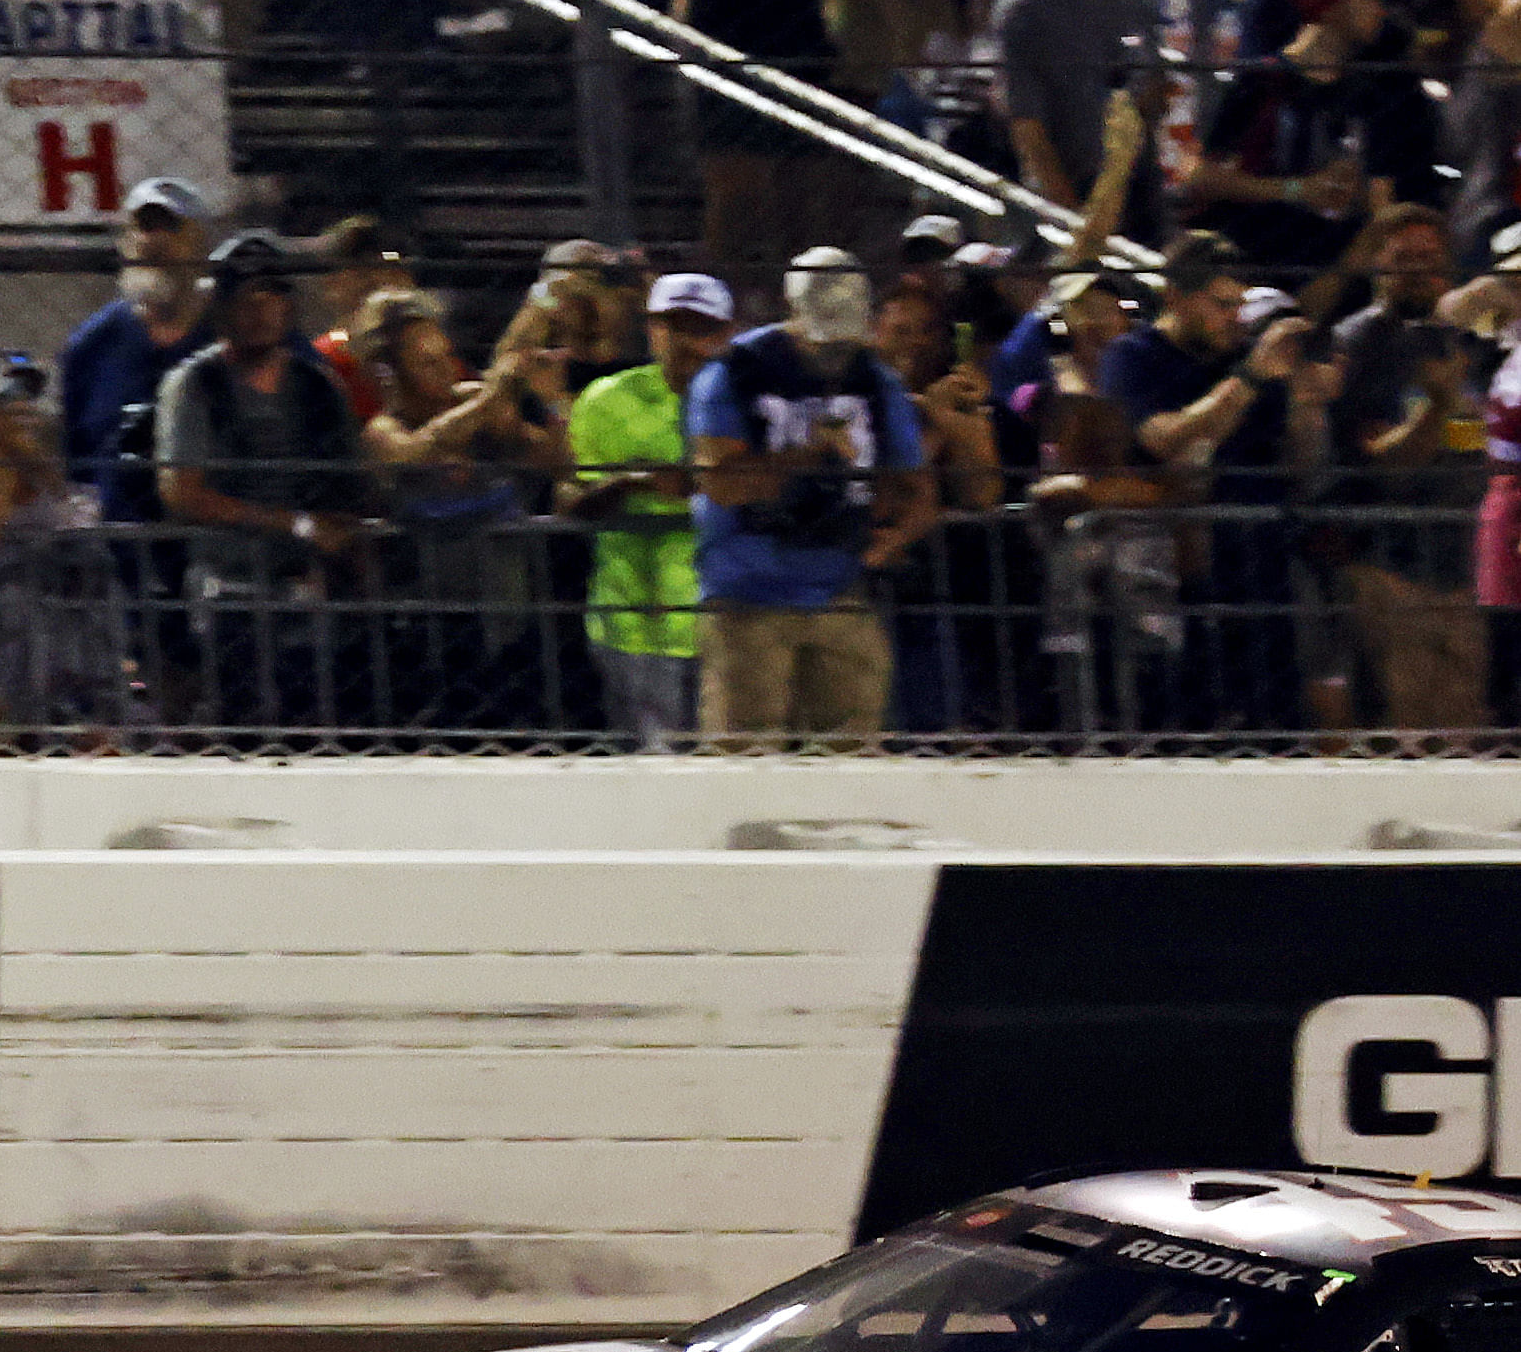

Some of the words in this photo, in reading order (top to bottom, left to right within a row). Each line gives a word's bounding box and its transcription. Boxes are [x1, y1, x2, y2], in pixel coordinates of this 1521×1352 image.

[39, 121, 123, 211] H
[1292, 994, 1521, 1180] G
[1117, 1238, 1306, 1292] REDDICK
